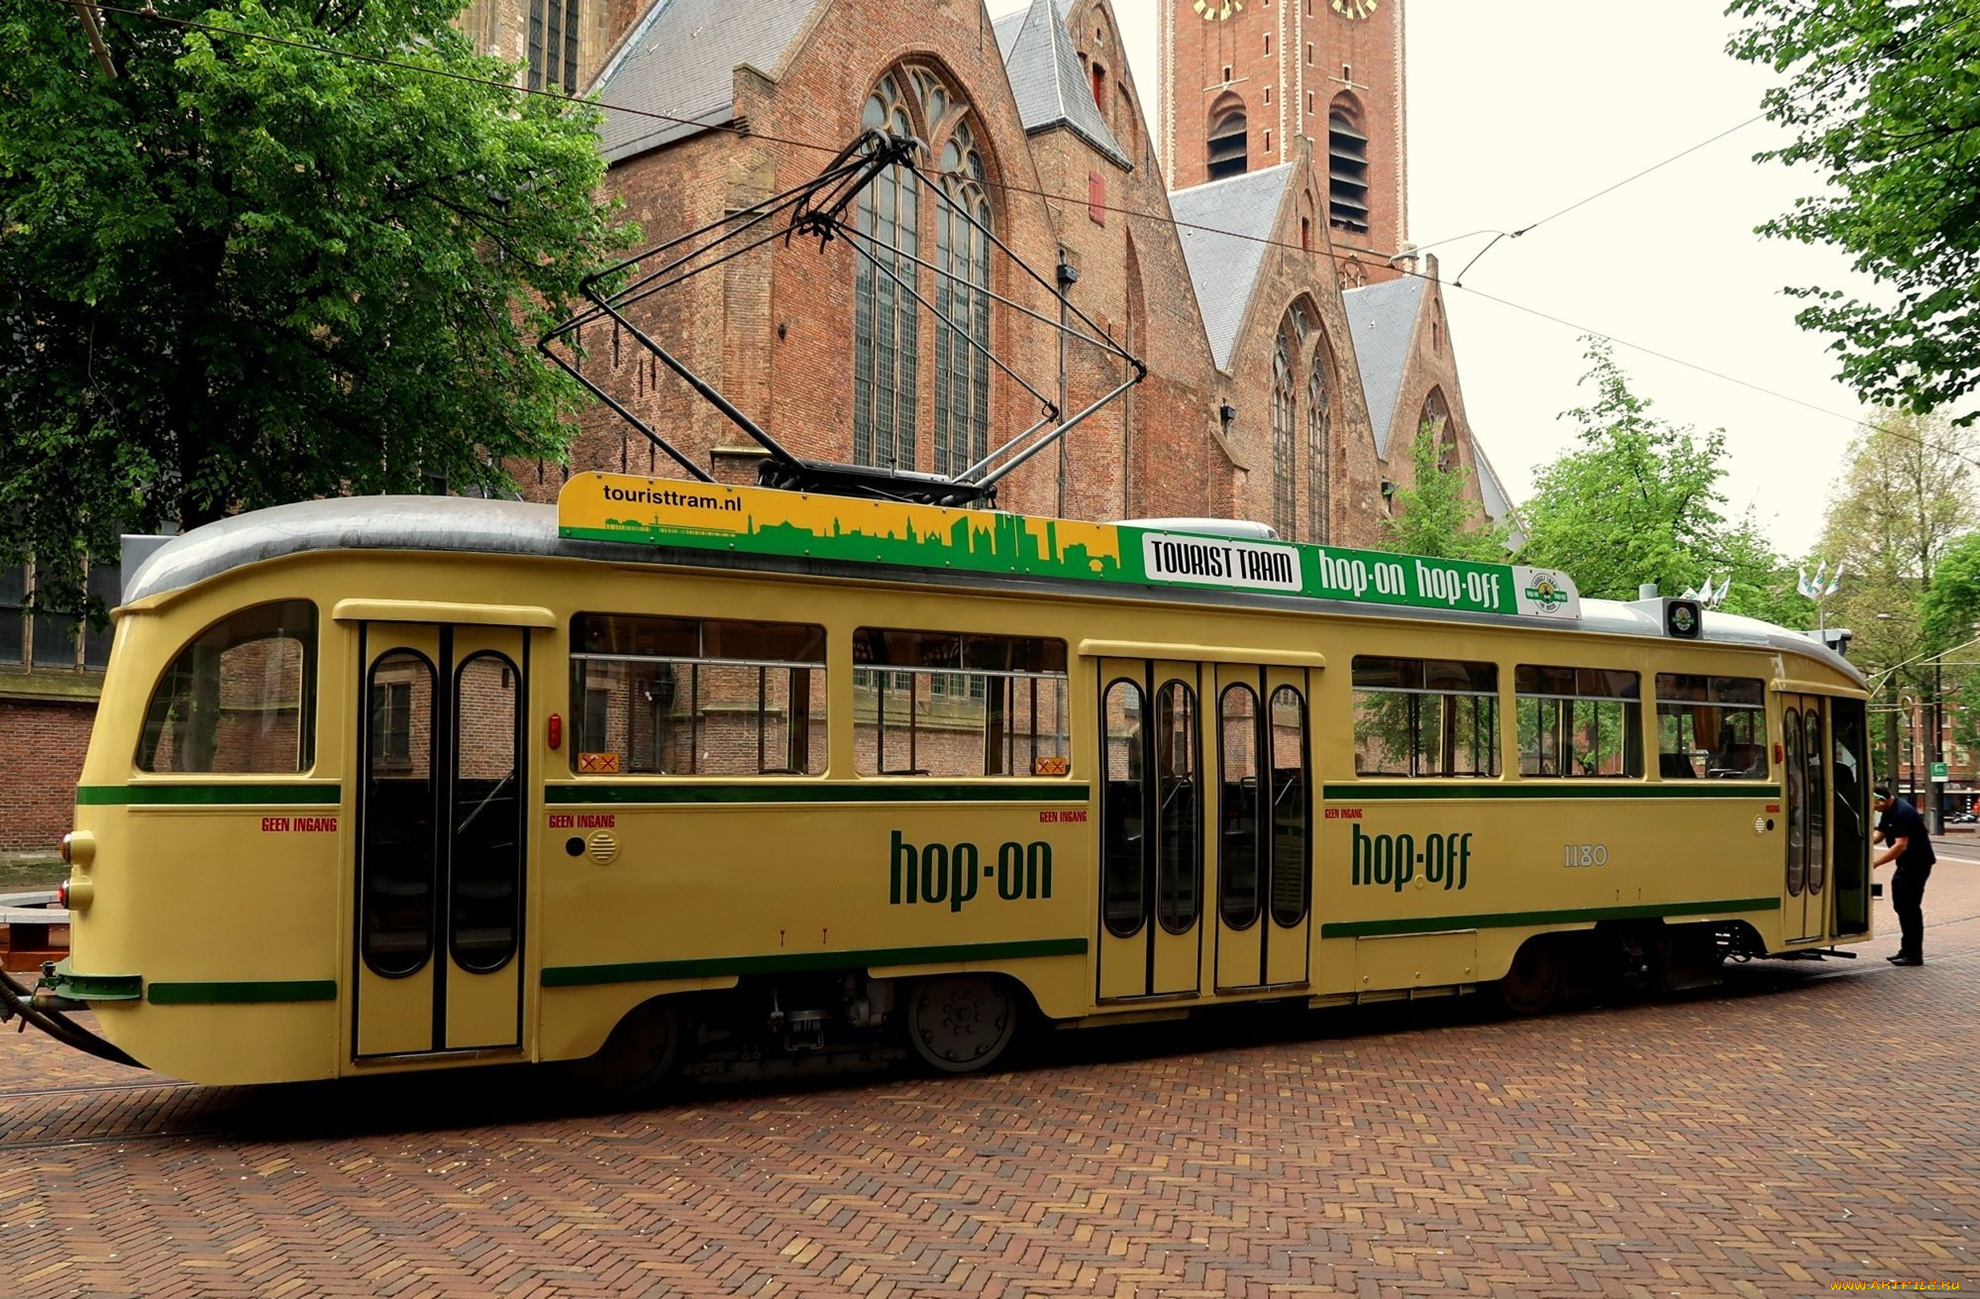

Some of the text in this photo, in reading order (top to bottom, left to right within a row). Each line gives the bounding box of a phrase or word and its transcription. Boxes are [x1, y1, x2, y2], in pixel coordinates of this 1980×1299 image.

[603, 485, 742, 512] touristtram.nl
[1151, 540, 1293, 583] TOURIST TRAM
[1039, 810, 1087, 822] GEEN INGANG
[1325, 808, 1363, 819] GEEN INGANG
[262, 817, 338, 832] GEEN INGANG
[549, 815, 615, 828] GEEN INGANG
[1563, 844, 1608, 868] 1180
